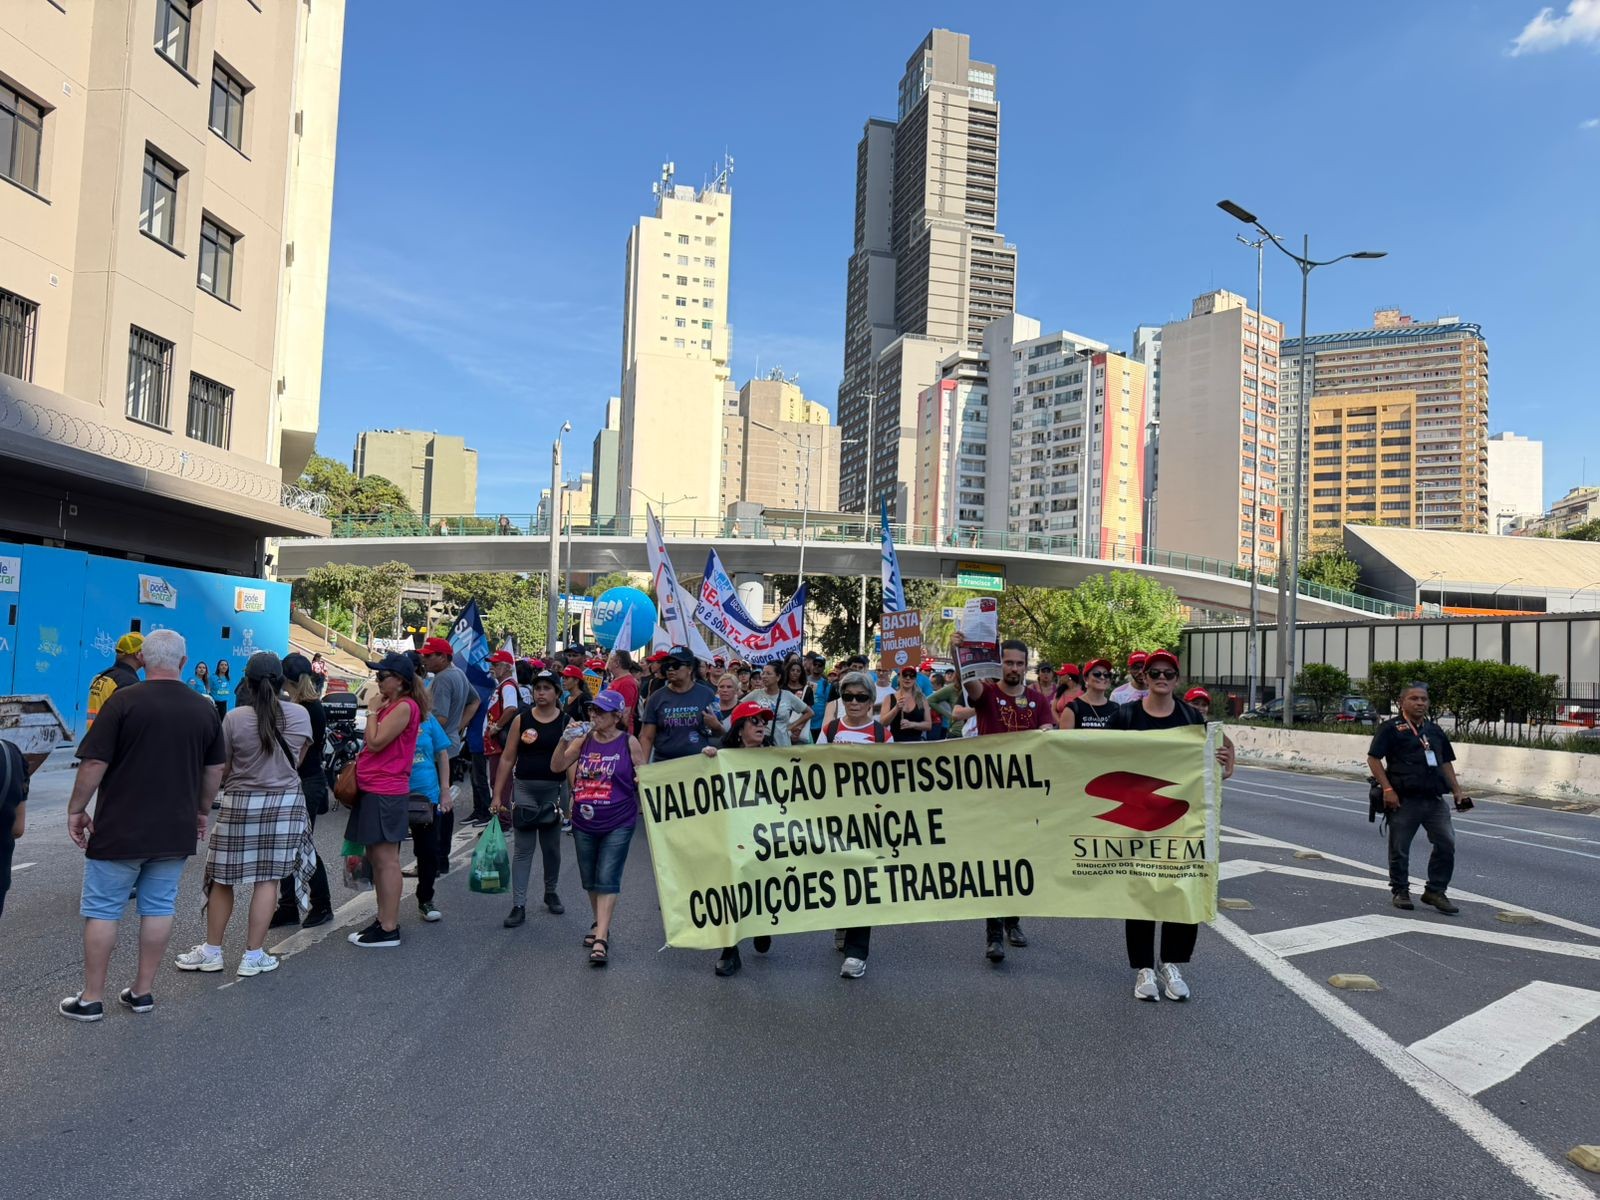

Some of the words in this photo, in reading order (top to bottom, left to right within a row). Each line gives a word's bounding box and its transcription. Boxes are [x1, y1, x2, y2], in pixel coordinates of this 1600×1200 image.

[882, 611, 919, 631] BASTA
[882, 635, 921, 652] VIOLÊNCIA!
[883, 630, 896, 640] DE
[644, 758, 827, 823] VALORIZAÇÃO
[833, 754, 1051, 798] PROFISSIONAL,
[753, 809, 923, 862] SEGURANÇA
[927, 808, 946, 846] E
[1073, 837, 1206, 860] SINPEEM
[1072, 868, 1114, 876] EDUCAÇÃO
[1129, 870, 1157, 878] ENSINO
[1135, 863, 1191, 871] PROFISSIONAIS
[689, 866, 837, 929] CONDIÇÕES
[843, 866, 882, 906] DE
[884, 858, 1035, 903] TRABALHO
